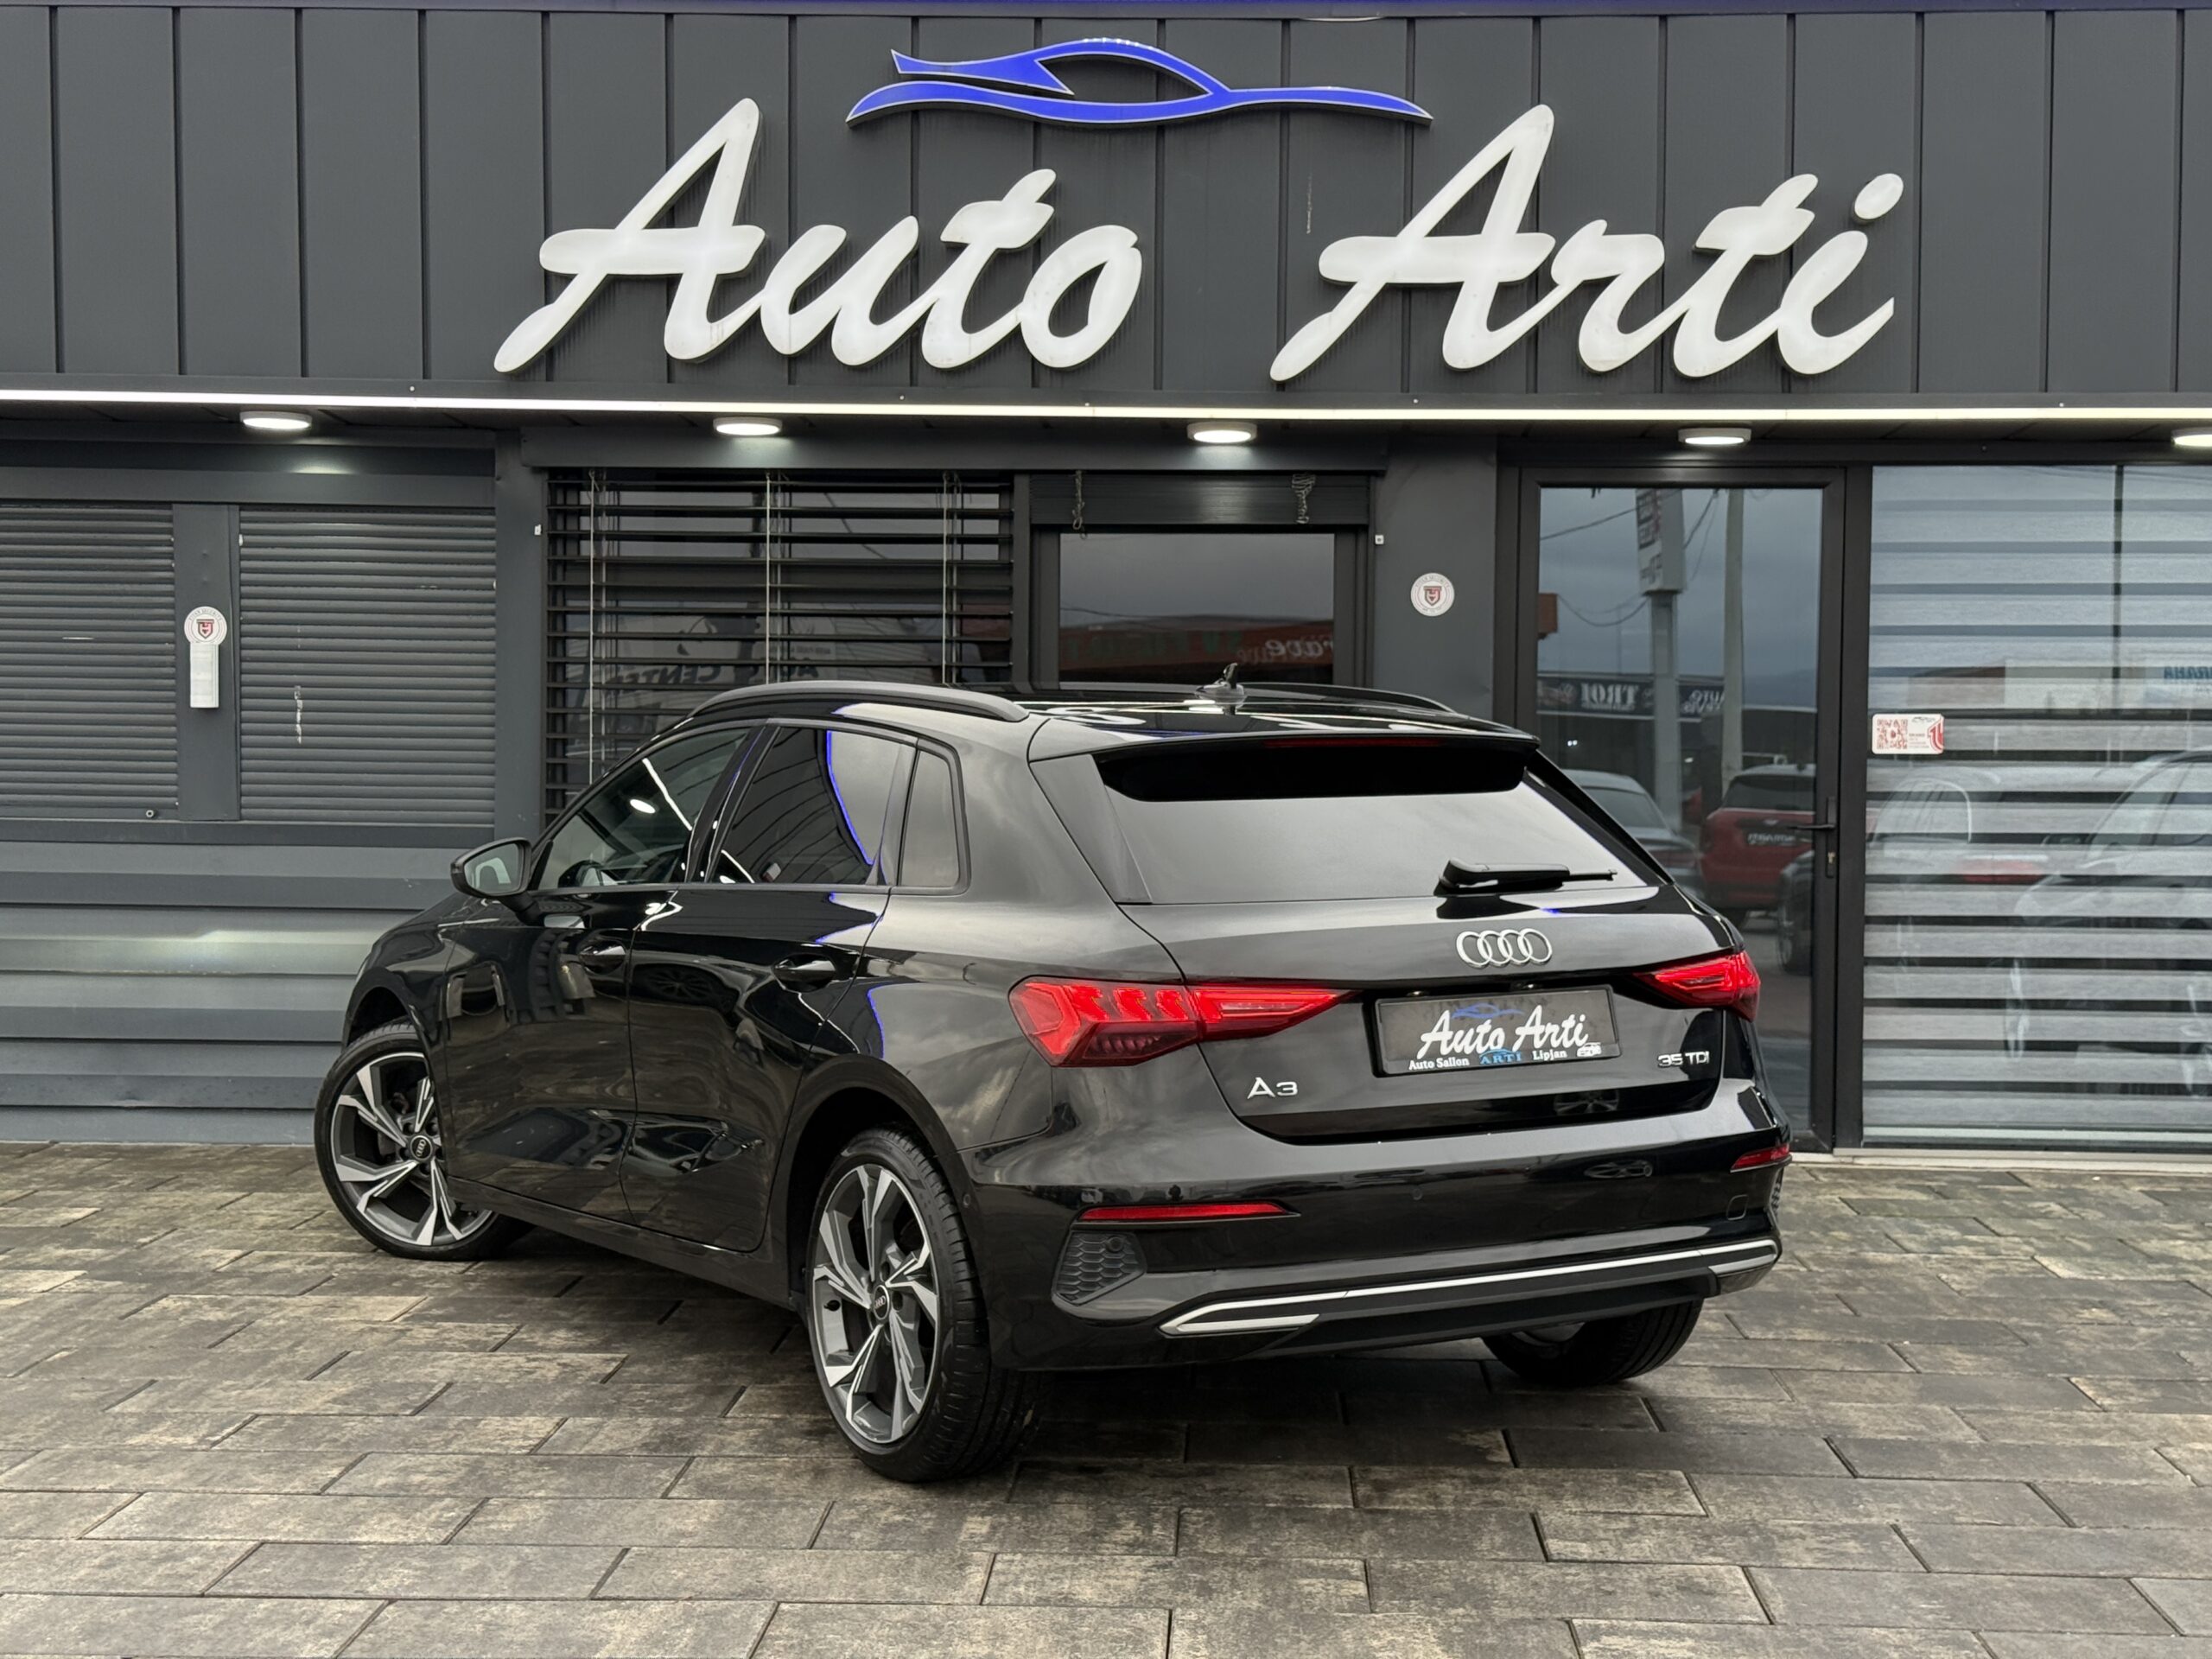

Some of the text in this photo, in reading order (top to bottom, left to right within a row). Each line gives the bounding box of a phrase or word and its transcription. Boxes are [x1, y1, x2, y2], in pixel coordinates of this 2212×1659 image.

[493, 98, 1904, 382] Auto Arti
[1416, 1005, 1589, 1059] Auto Arti
[1408, 1059, 1434, 1071] Auto
[1480, 1052, 1522, 1065] ARTI
[1532, 1049, 1567, 1061] Lipjan
[1657, 1050, 1710, 1067] 35 TDI
[1247, 1077, 1298, 1099] A3
